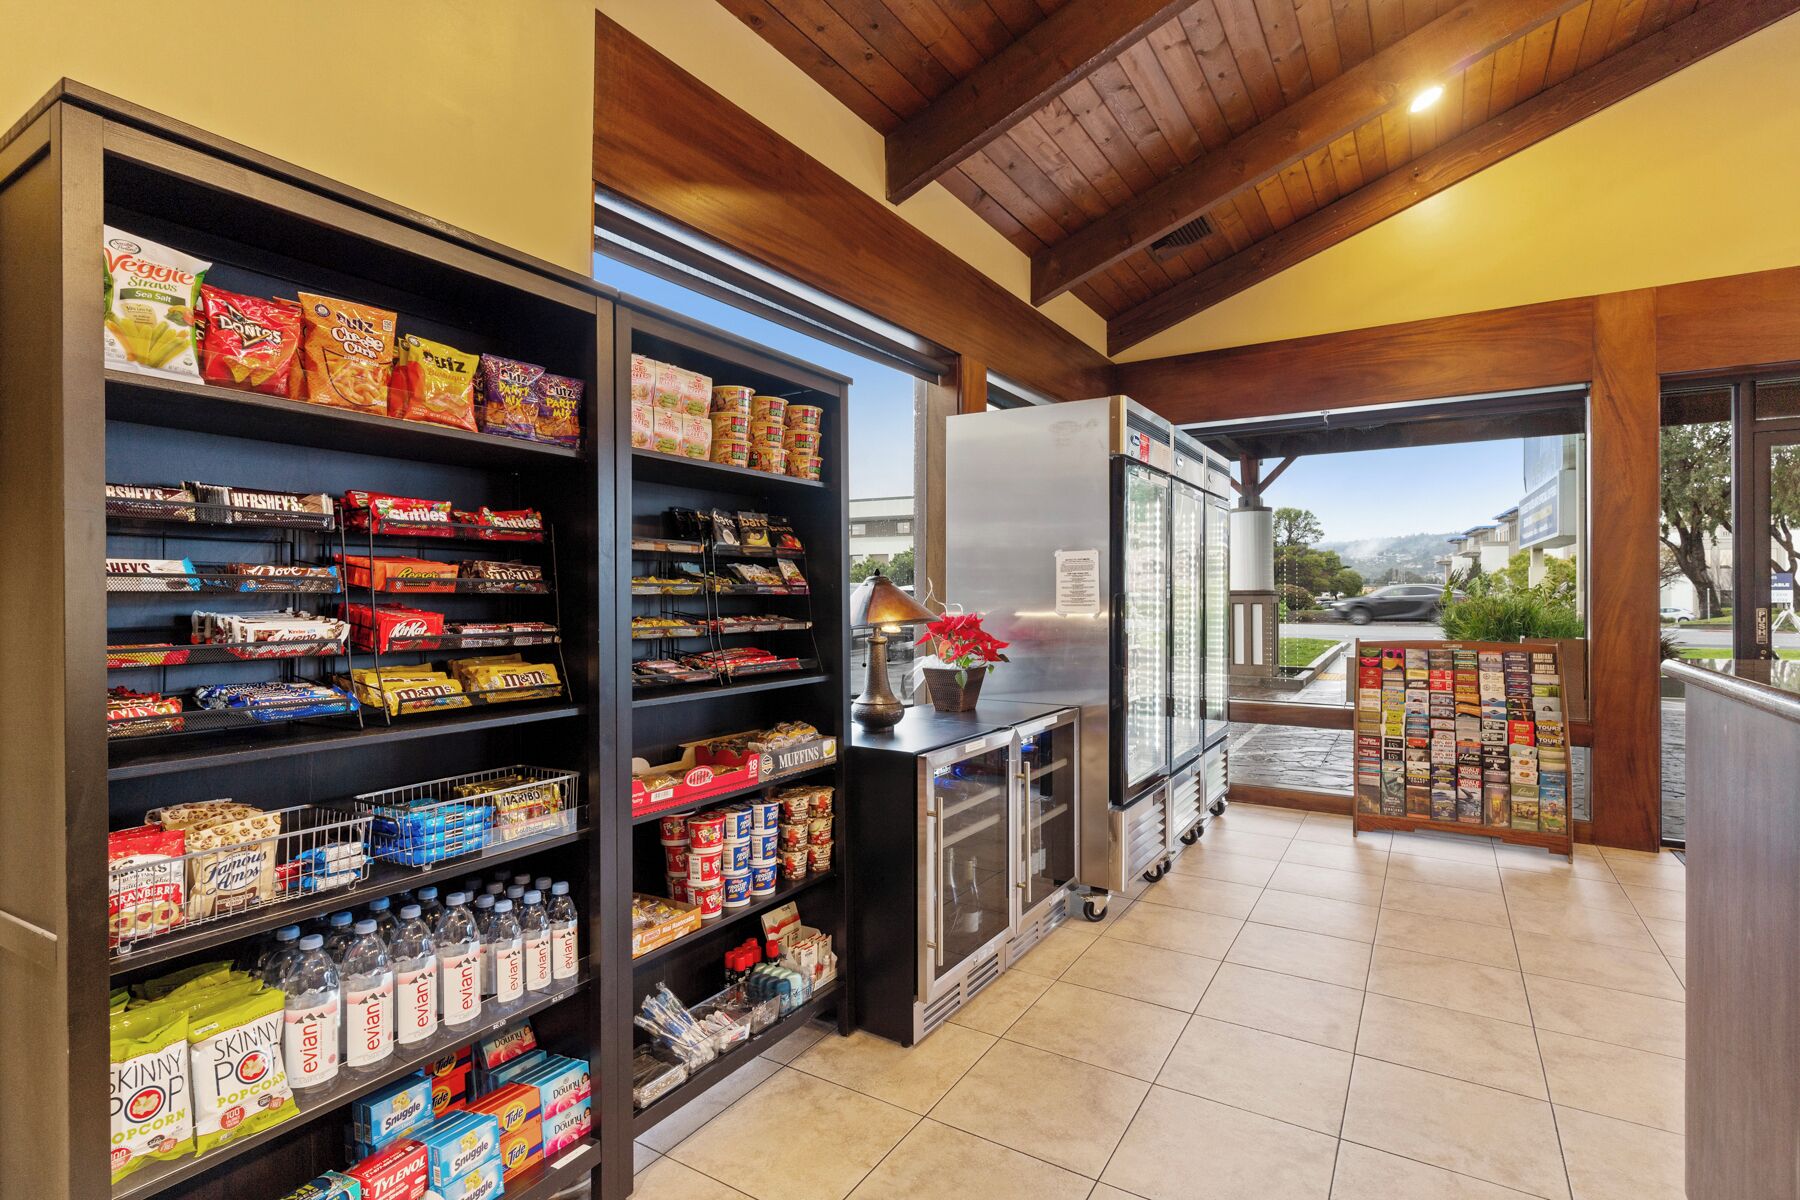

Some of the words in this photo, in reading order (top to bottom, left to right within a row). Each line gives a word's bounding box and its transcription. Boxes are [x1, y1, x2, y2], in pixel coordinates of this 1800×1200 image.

[104, 248, 195, 286] Veggie
[128, 276, 177, 292] Straws
[135, 290, 153, 298] Sea
[155, 293, 172, 303] Salt
[331, 326, 384, 352] Cheese
[498, 380, 530, 396] PARTY
[505, 396, 523, 407] MIX
[546, 397, 577, 410] PARTY
[553, 408, 572, 420] MIX
[106, 485, 164, 501] RSHEY'S
[232, 492, 299, 512] HERSHEY'S
[388, 508, 449, 521] Skittles
[492, 517, 541, 529] Skittles
[740, 514, 768, 527] bare
[106, 562, 152, 574] HEY'S
[1758, 611, 1766, 636] PUSH
[748, 759, 757, 771] 18
[779, 748, 820, 770] MUFFINS
[502, 790, 541, 807] HARIBO
[203, 851, 267, 884] Famous
[208, 866, 260, 894] Amos
[537, 947, 548, 980] evian
[563, 937, 573, 969] evian
[509, 958, 519, 991] evian
[459, 966, 473, 1011] evian
[414, 981, 429, 1028] evian
[363, 1003, 380, 1051] evian
[213, 1016, 281, 1062] SKINNY
[300, 1023, 318, 1073] evian
[494, 1030, 523, 1049] Downy
[216, 1071, 286, 1109] POPCORN
[432, 1091, 450, 1108] Tide
[552, 1078, 581, 1100] Downy
[112, 1107, 186, 1145] OPCORN
[384, 1101, 422, 1131] Snuggle
[505, 1107, 525, 1130] Tide
[554, 1113, 582, 1135] Downy
[454, 1140, 489, 1172] Snuggle
[507, 1143, 527, 1166] Tide
[373, 1154, 427, 1198] TYLENOL
